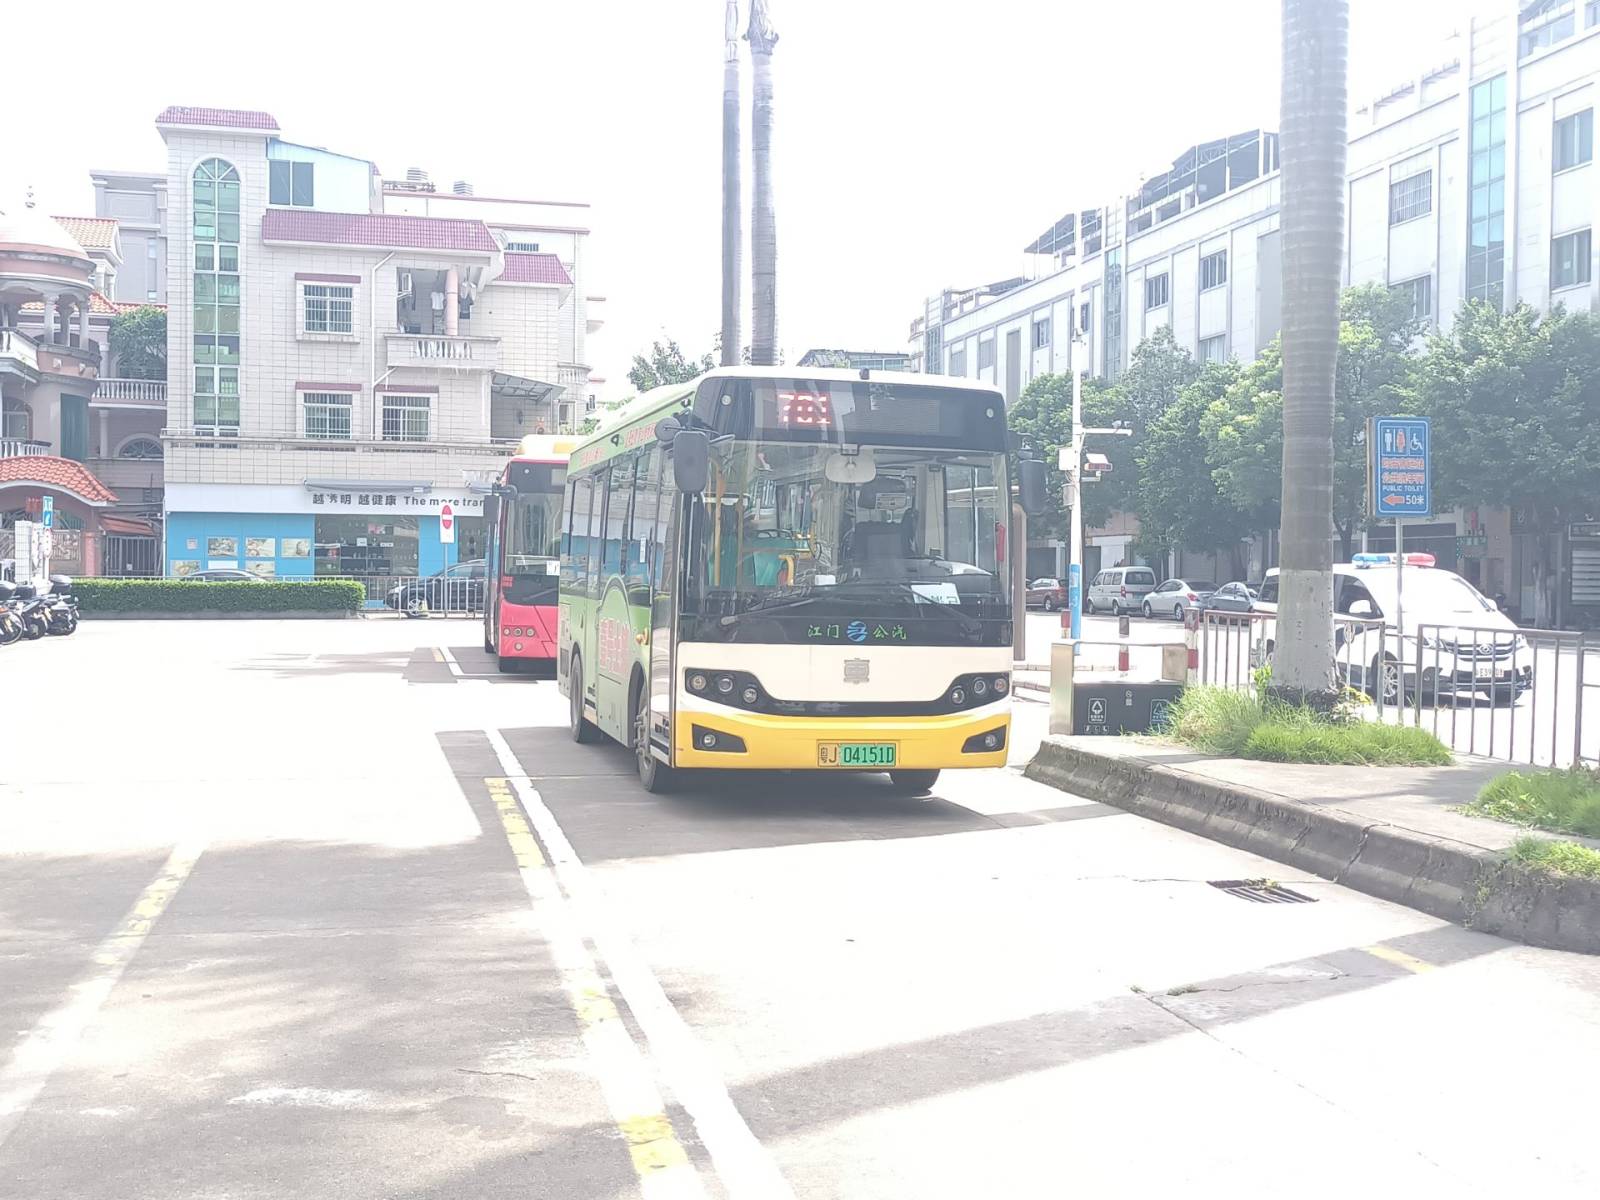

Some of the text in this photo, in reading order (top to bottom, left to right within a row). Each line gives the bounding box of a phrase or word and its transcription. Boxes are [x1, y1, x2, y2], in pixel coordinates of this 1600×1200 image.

[358, 494, 397, 506] 越健康
[404, 496, 427, 506] The
[1405, 494, 1425, 505] 50米
[807, 624, 907, 640] 江门 公汽
